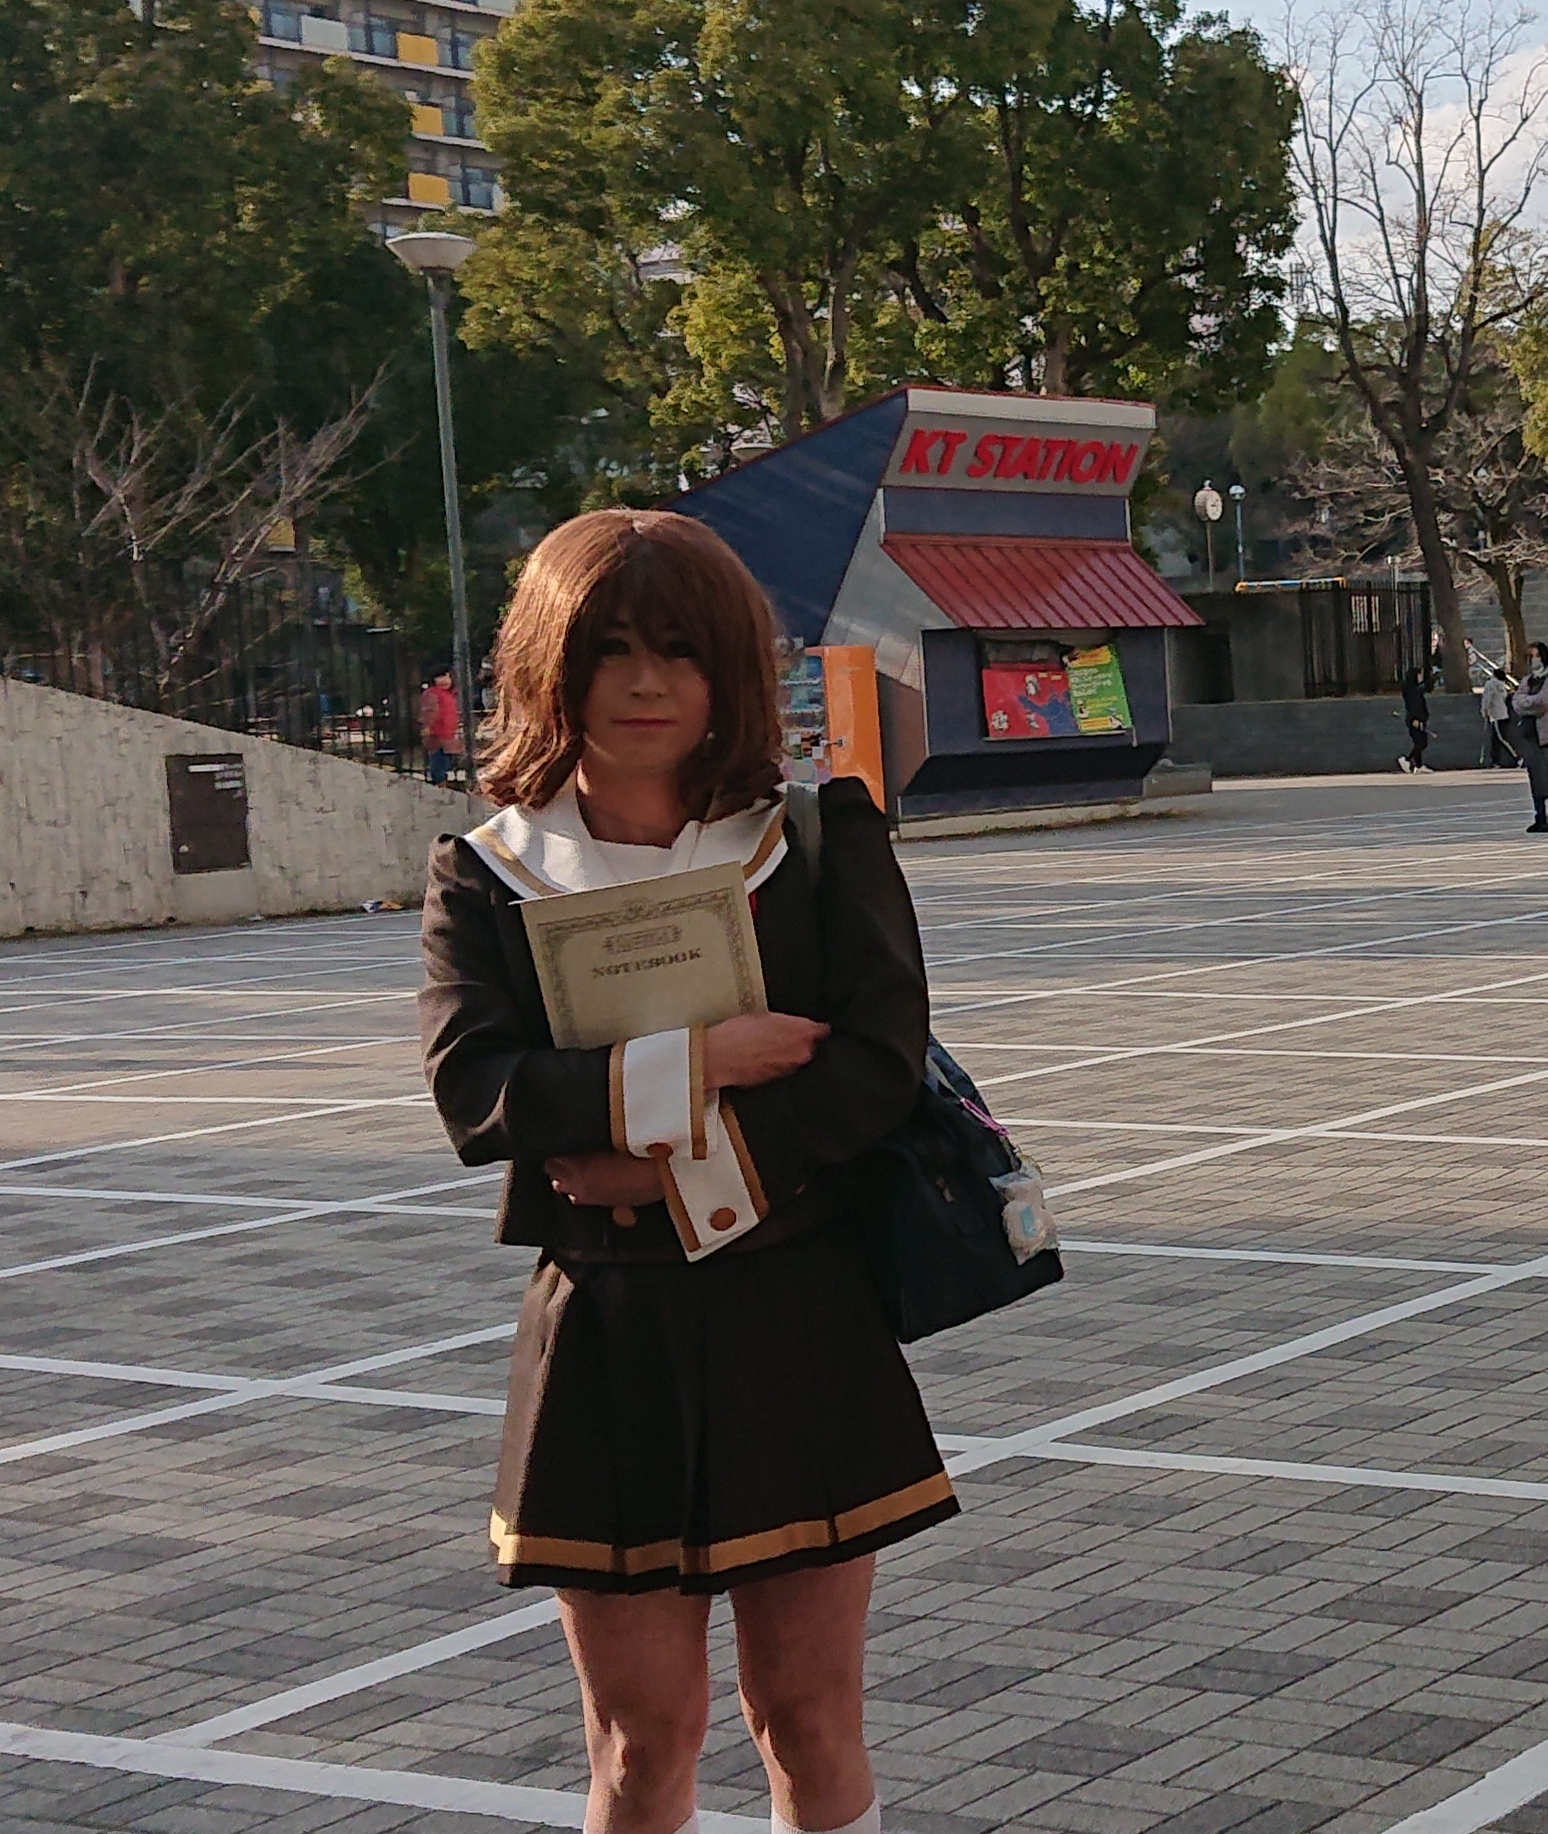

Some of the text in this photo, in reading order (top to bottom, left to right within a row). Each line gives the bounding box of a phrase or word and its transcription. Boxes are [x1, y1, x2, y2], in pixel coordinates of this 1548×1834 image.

[900, 428, 1139, 484] KT STATION
[591, 948, 702, 978] NOTEBOOK
